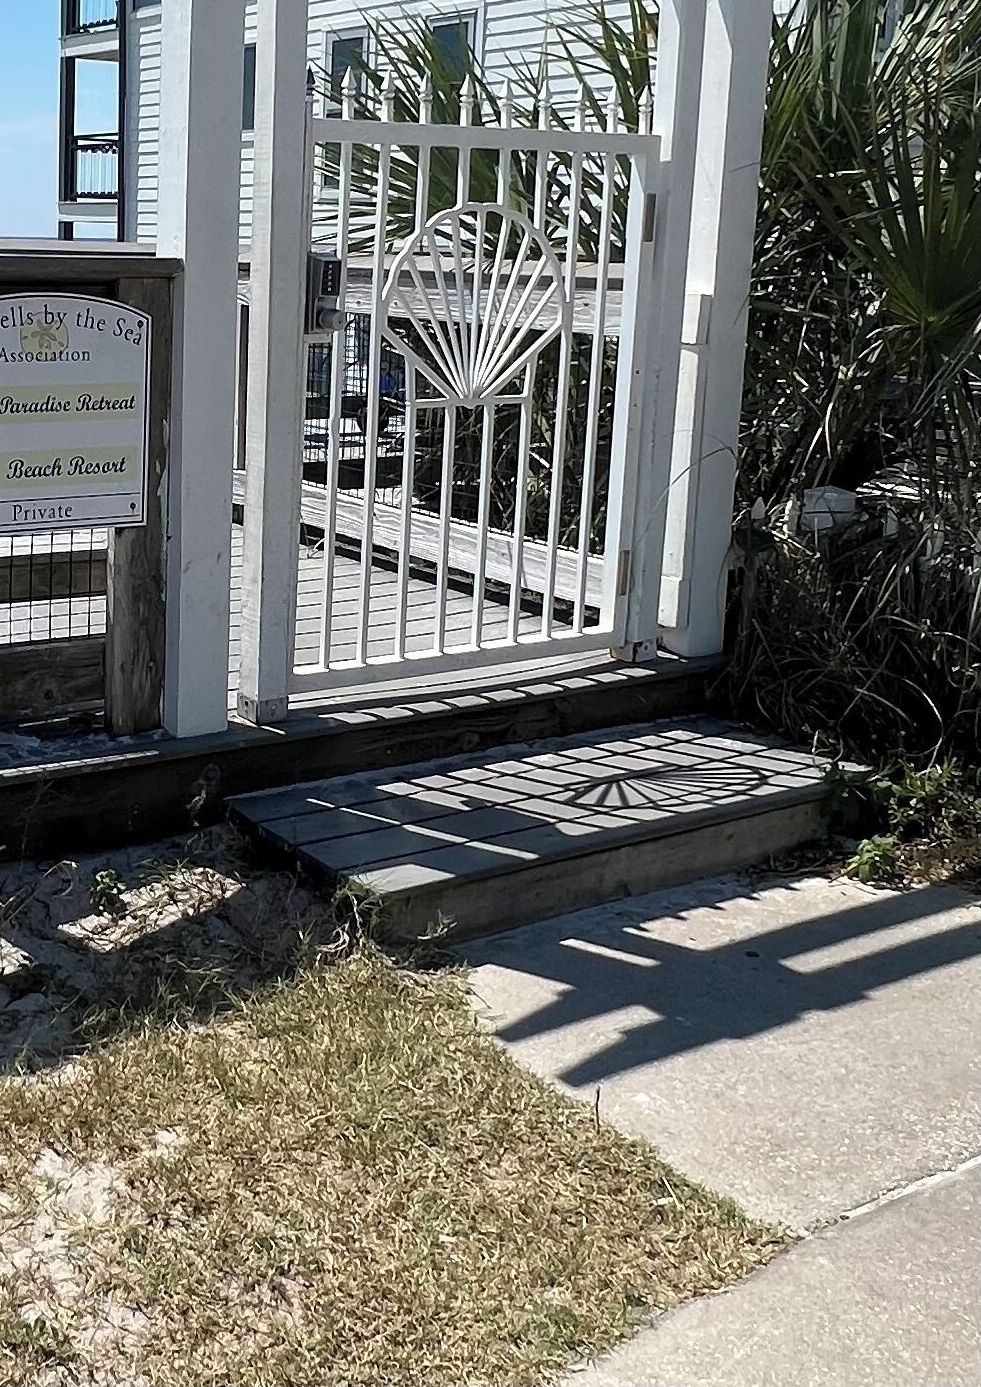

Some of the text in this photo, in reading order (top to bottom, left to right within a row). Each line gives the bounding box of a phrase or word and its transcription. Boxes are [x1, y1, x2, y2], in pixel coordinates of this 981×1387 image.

[43, 304, 68, 330] by
[75, 307, 106, 332] the
[112, 317, 142, 346] Sea
[75, 393, 136, 412] Retreat
[6, 455, 126, 480] Beach Resort
[12, 503, 73, 521] Private
